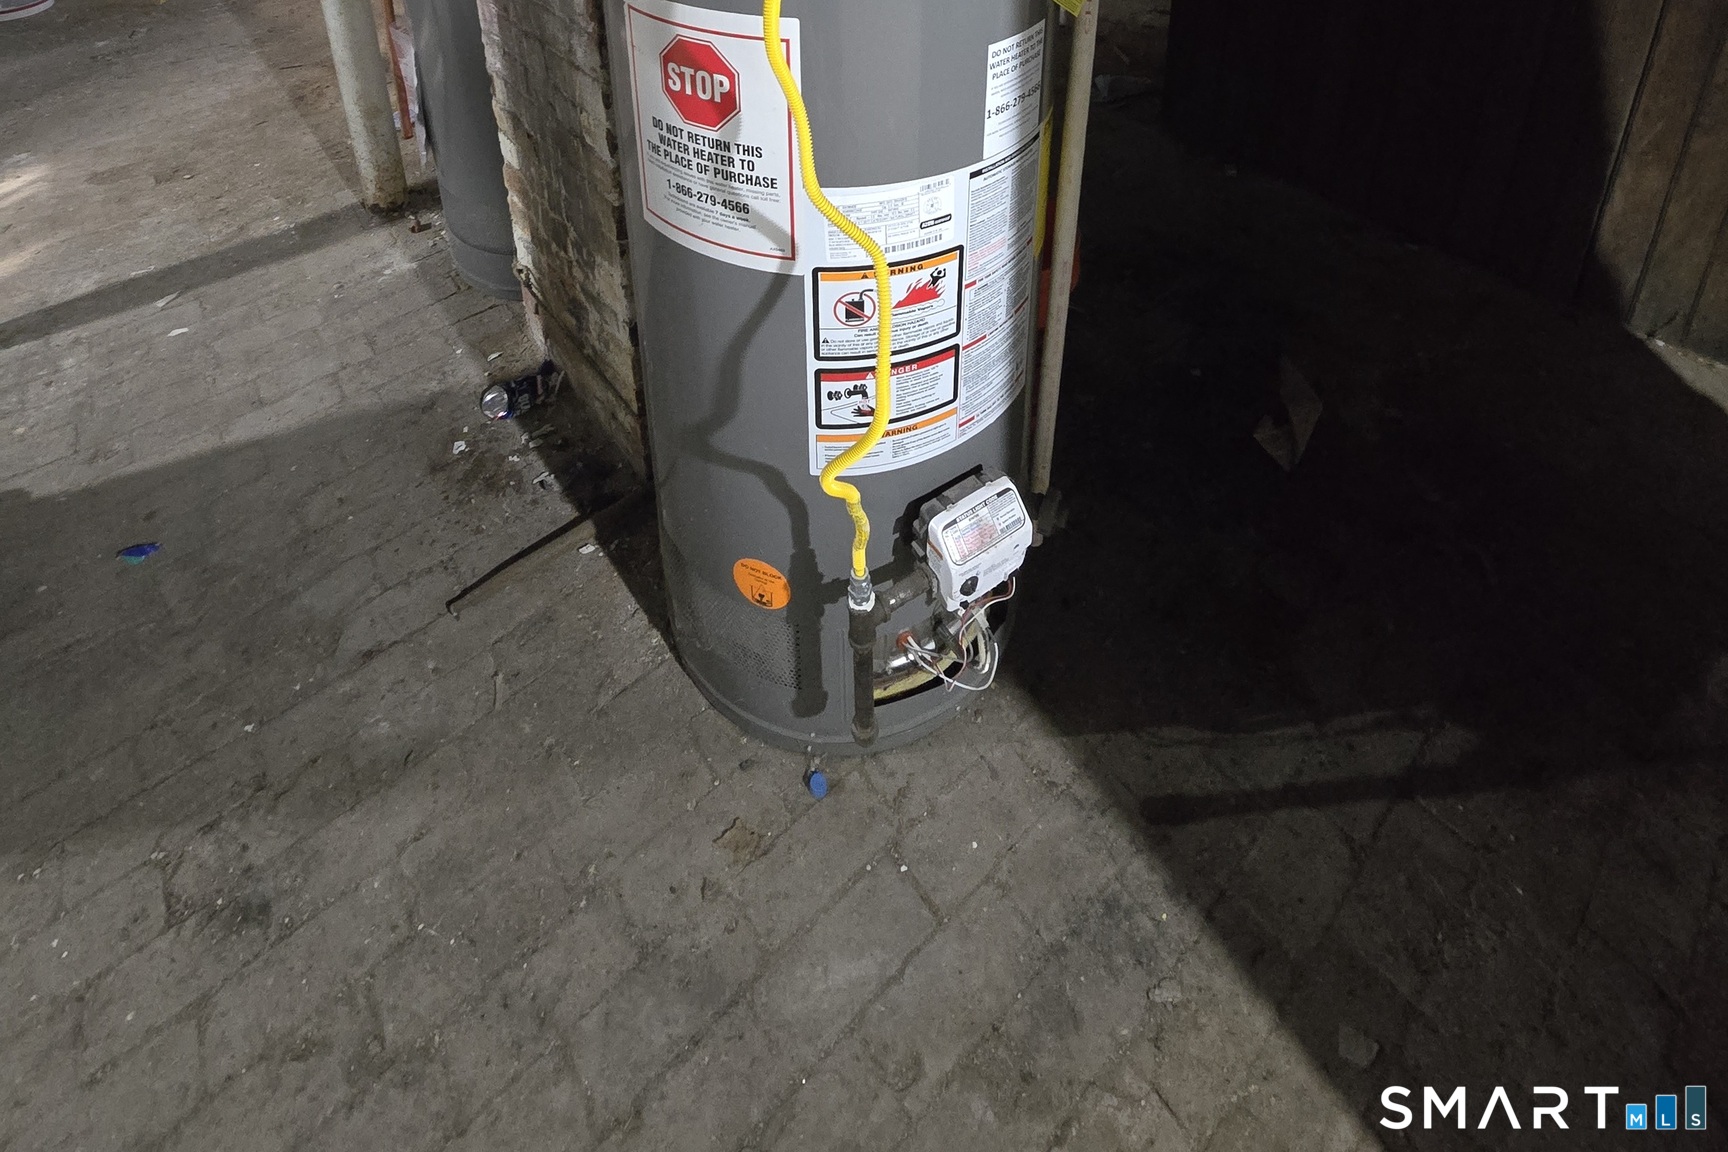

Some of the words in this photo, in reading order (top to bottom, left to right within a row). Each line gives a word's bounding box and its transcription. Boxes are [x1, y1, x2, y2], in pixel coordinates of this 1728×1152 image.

[989, 56, 1011, 70] WATER
[992, 50, 1002, 59] DO
[1003, 44, 1015, 54] NOT
[667, 62, 731, 103] STOP
[992, 69, 1010, 80] PLACE
[652, 116, 664, 132] DO
[666, 120, 684, 140] NOT
[687, 131, 731, 154] RETURN
[734, 143, 763, 159] THIS
[658, 133, 690, 156] WATER
[693, 148, 735, 169] HEATER
[739, 159, 755, 172] TO
[647, 139, 662, 157] THE
[664, 149, 693, 171] PLACE
[697, 162, 710, 176] OF
[714, 167, 778, 190] PURCHASE
[667, 179, 750, 215] 1-866-279-4566
